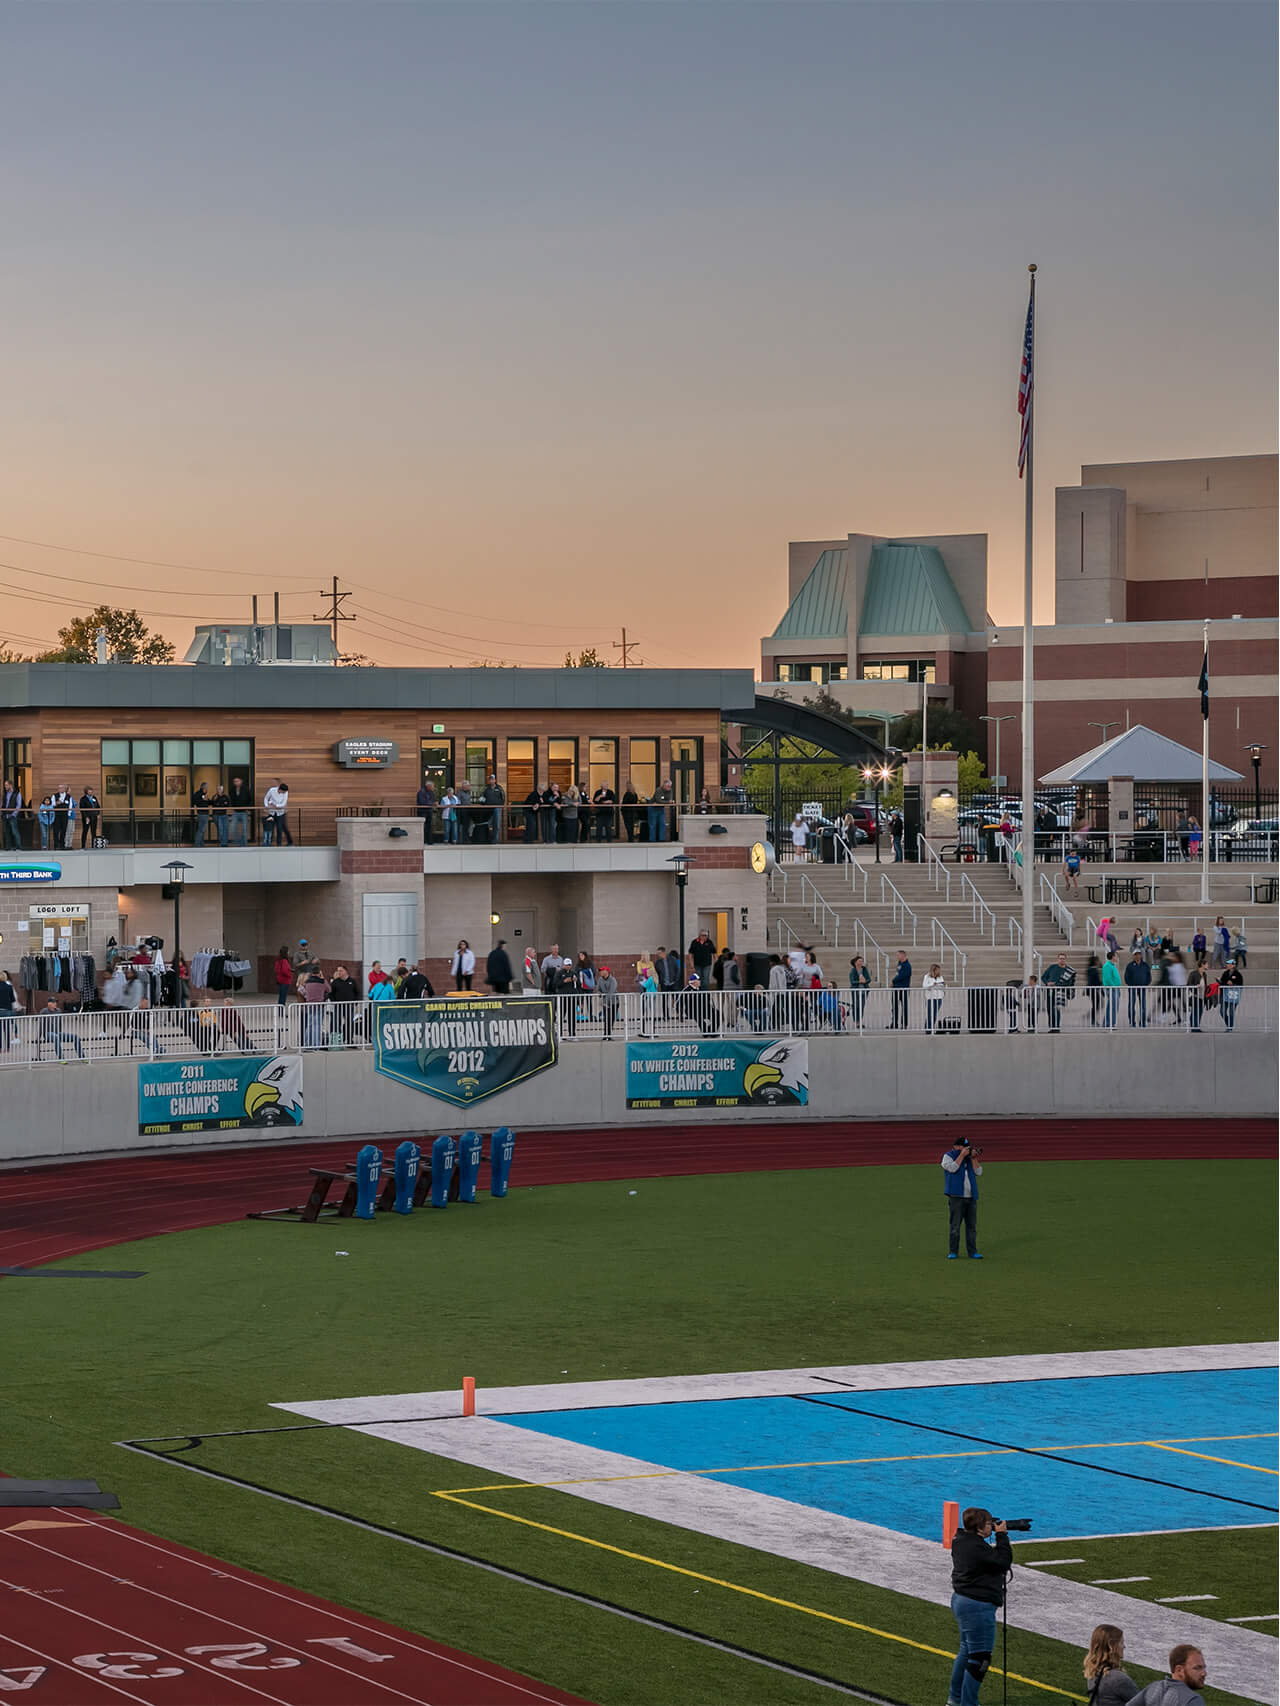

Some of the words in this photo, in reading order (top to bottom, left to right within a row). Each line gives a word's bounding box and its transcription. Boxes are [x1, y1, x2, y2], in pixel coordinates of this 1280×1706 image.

[425, 1003, 446, 1011] GRAND
[447, 1002, 468, 1011] RAPIDS
[469, 1001, 502, 1010] CHRISTIAN
[383, 1022, 422, 1050] STATE
[424, 1021, 488, 1049] FOOTBALL
[489, 1018, 547, 1047] CHAMPS
[672, 1044, 699, 1057] 2012
[448, 1050, 485, 1073] 2012
[631, 1060, 644, 1073] OK
[645, 1059, 675, 1073] WHITE
[676, 1058, 735, 1072] CONFERENCE
[181, 1065, 204, 1079] 2011
[144, 1083, 156, 1097] OK
[157, 1081, 184, 1096] WHITE
[185, 1078, 238, 1094] CONFERENCE
[659, 1074, 714, 1092] CHAMPS
[171, 1095, 219, 1116] CHAMPS
[632, 1100, 661, 1108] ATTITUDE
[674, 1099, 697, 1107] CHRIST
[716, 1098, 738, 1106] EFFORT
[182, 1122, 203, 1131] CHRIST
[220, 1119, 240, 1129] EFFORT
[184, 1642, 302, 1670] 2
[306, 1637, 394, 1663] 1
[71, 1652, 184, 1680] 3
